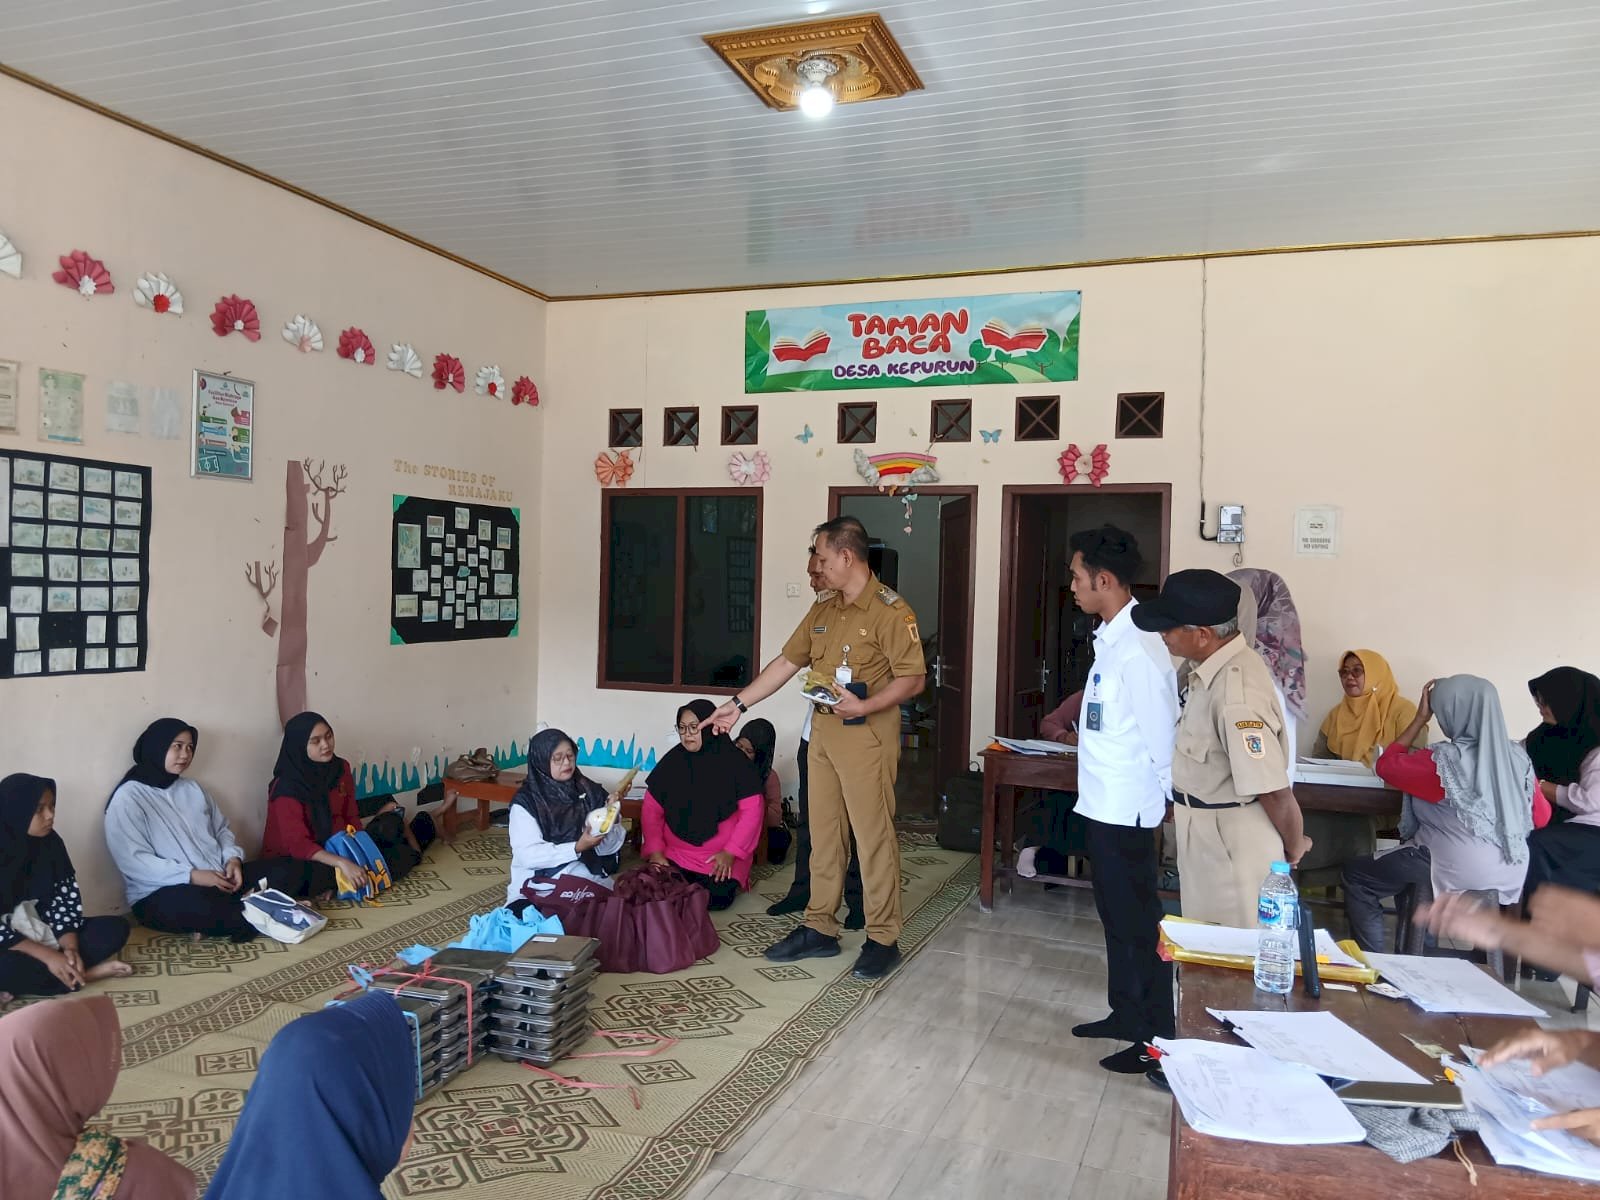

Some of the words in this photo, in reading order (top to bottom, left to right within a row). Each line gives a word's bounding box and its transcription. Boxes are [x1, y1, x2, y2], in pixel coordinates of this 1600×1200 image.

[848, 308, 969, 337] TAMAN
[861, 332, 952, 360] BACA
[833, 363, 881, 379] DESA
[887, 359, 976, 376] KEPURUN
[393, 459, 418, 475] The
[424, 464, 478, 484] STORIES
[481, 473, 496, 488] OF
[448, 484, 513, 502] REMAJAKU
